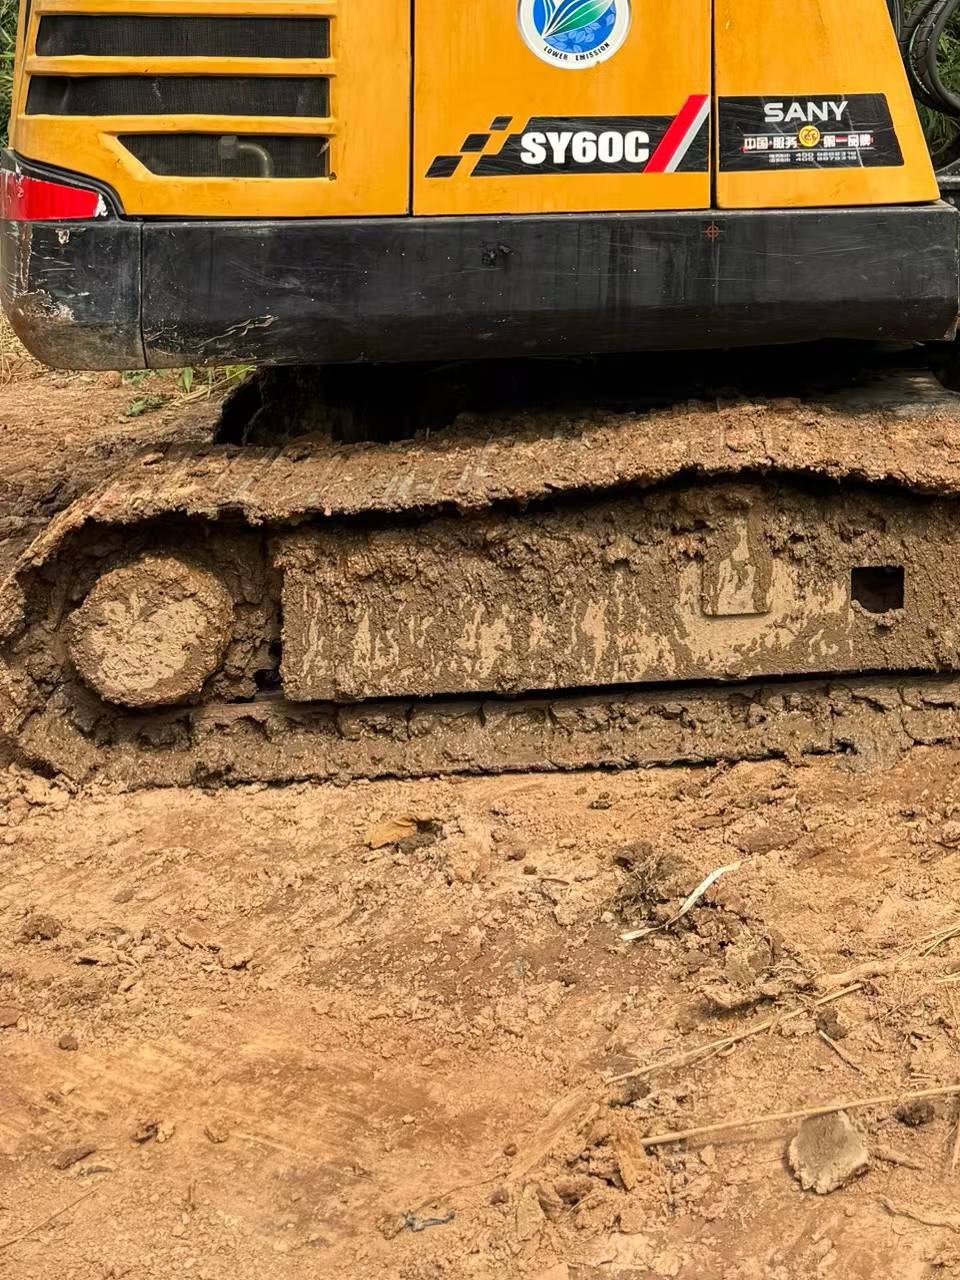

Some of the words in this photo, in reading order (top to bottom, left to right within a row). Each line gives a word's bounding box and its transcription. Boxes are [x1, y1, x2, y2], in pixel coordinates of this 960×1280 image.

[544, 46, 568, 61] LOWER
[575, 42, 610, 61] EMISSION
[764, 101, 848, 123] SANY
[520, 130, 650, 164] SY60C
